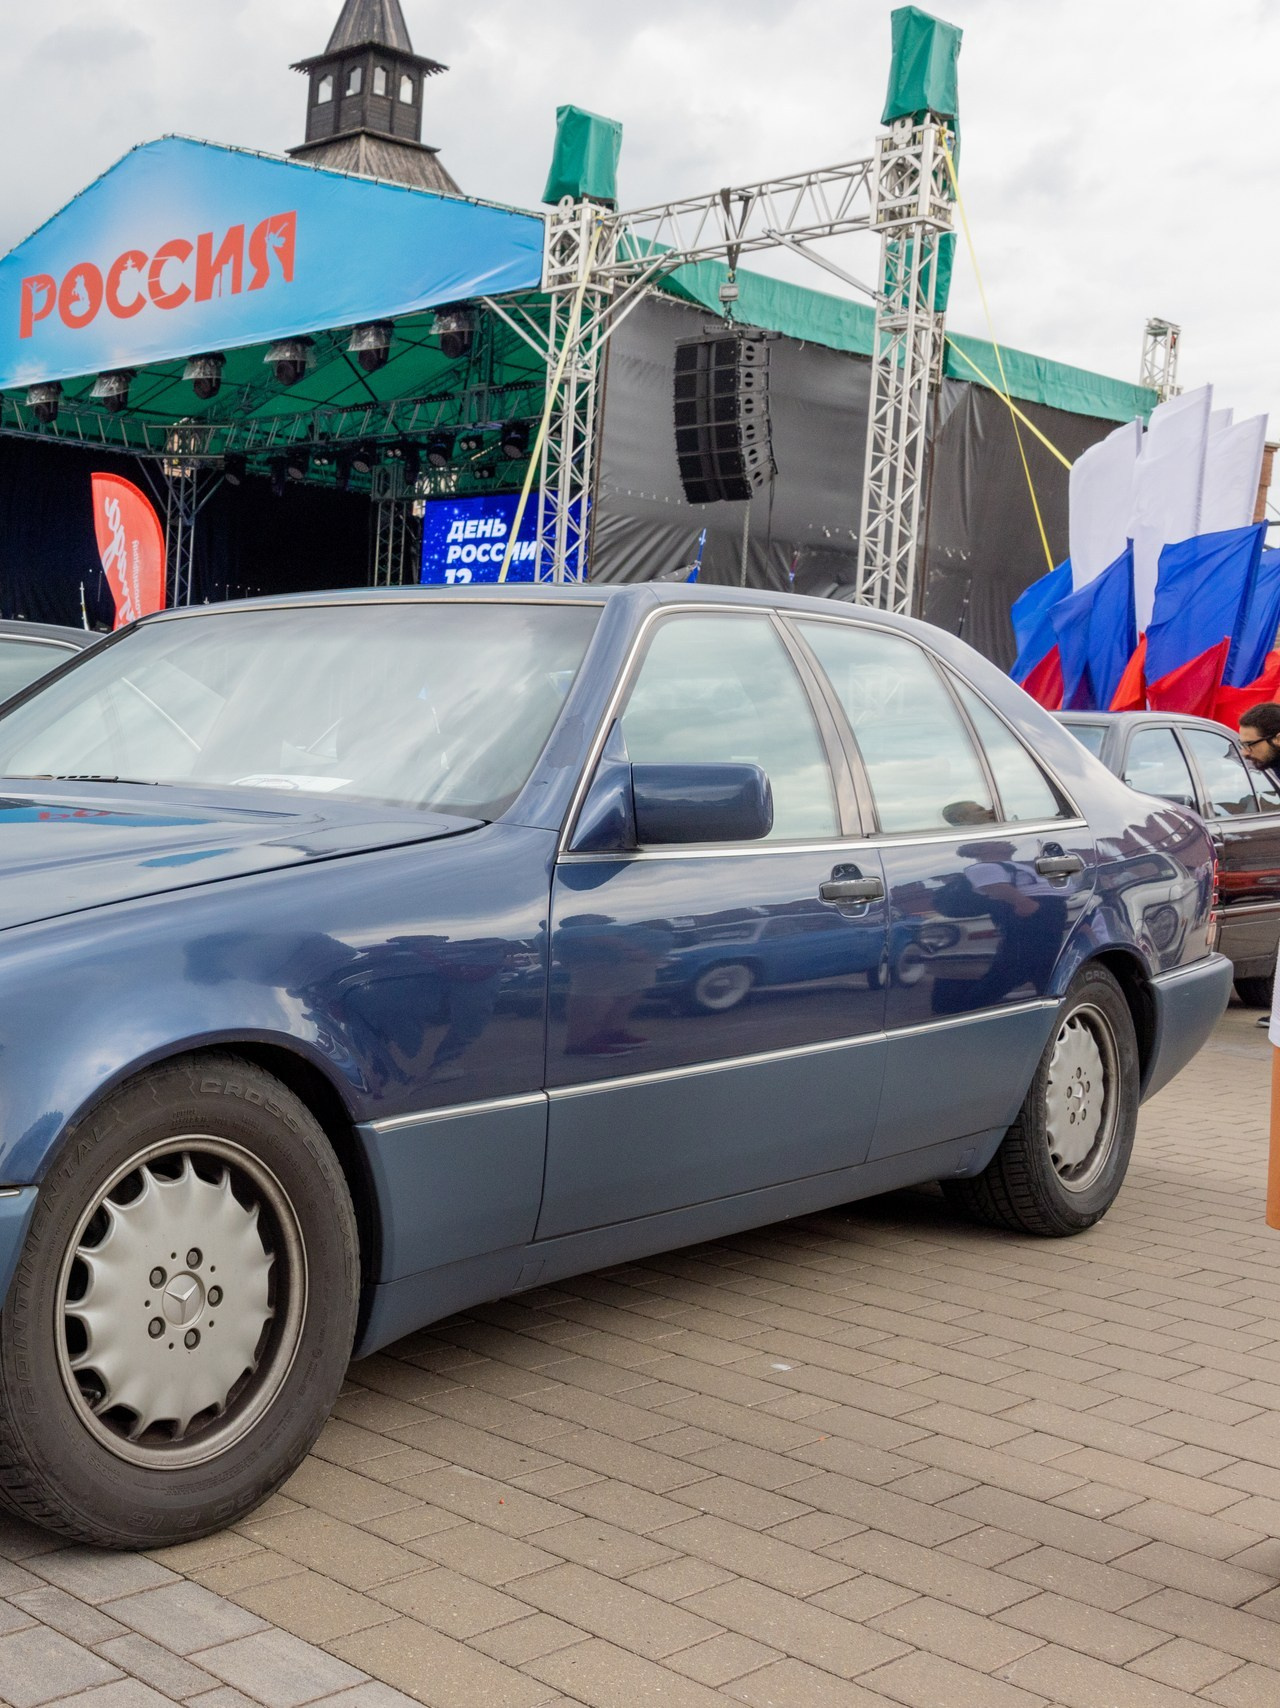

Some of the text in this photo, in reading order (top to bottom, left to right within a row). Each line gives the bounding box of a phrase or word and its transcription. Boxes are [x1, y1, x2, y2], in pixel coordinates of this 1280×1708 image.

[19, 210, 297, 339] РОССИЯ
[446, 518, 507, 543] ДЕНЬ
[446, 540, 543, 564] РОССИИ
[444, 567, 472, 584] 12
